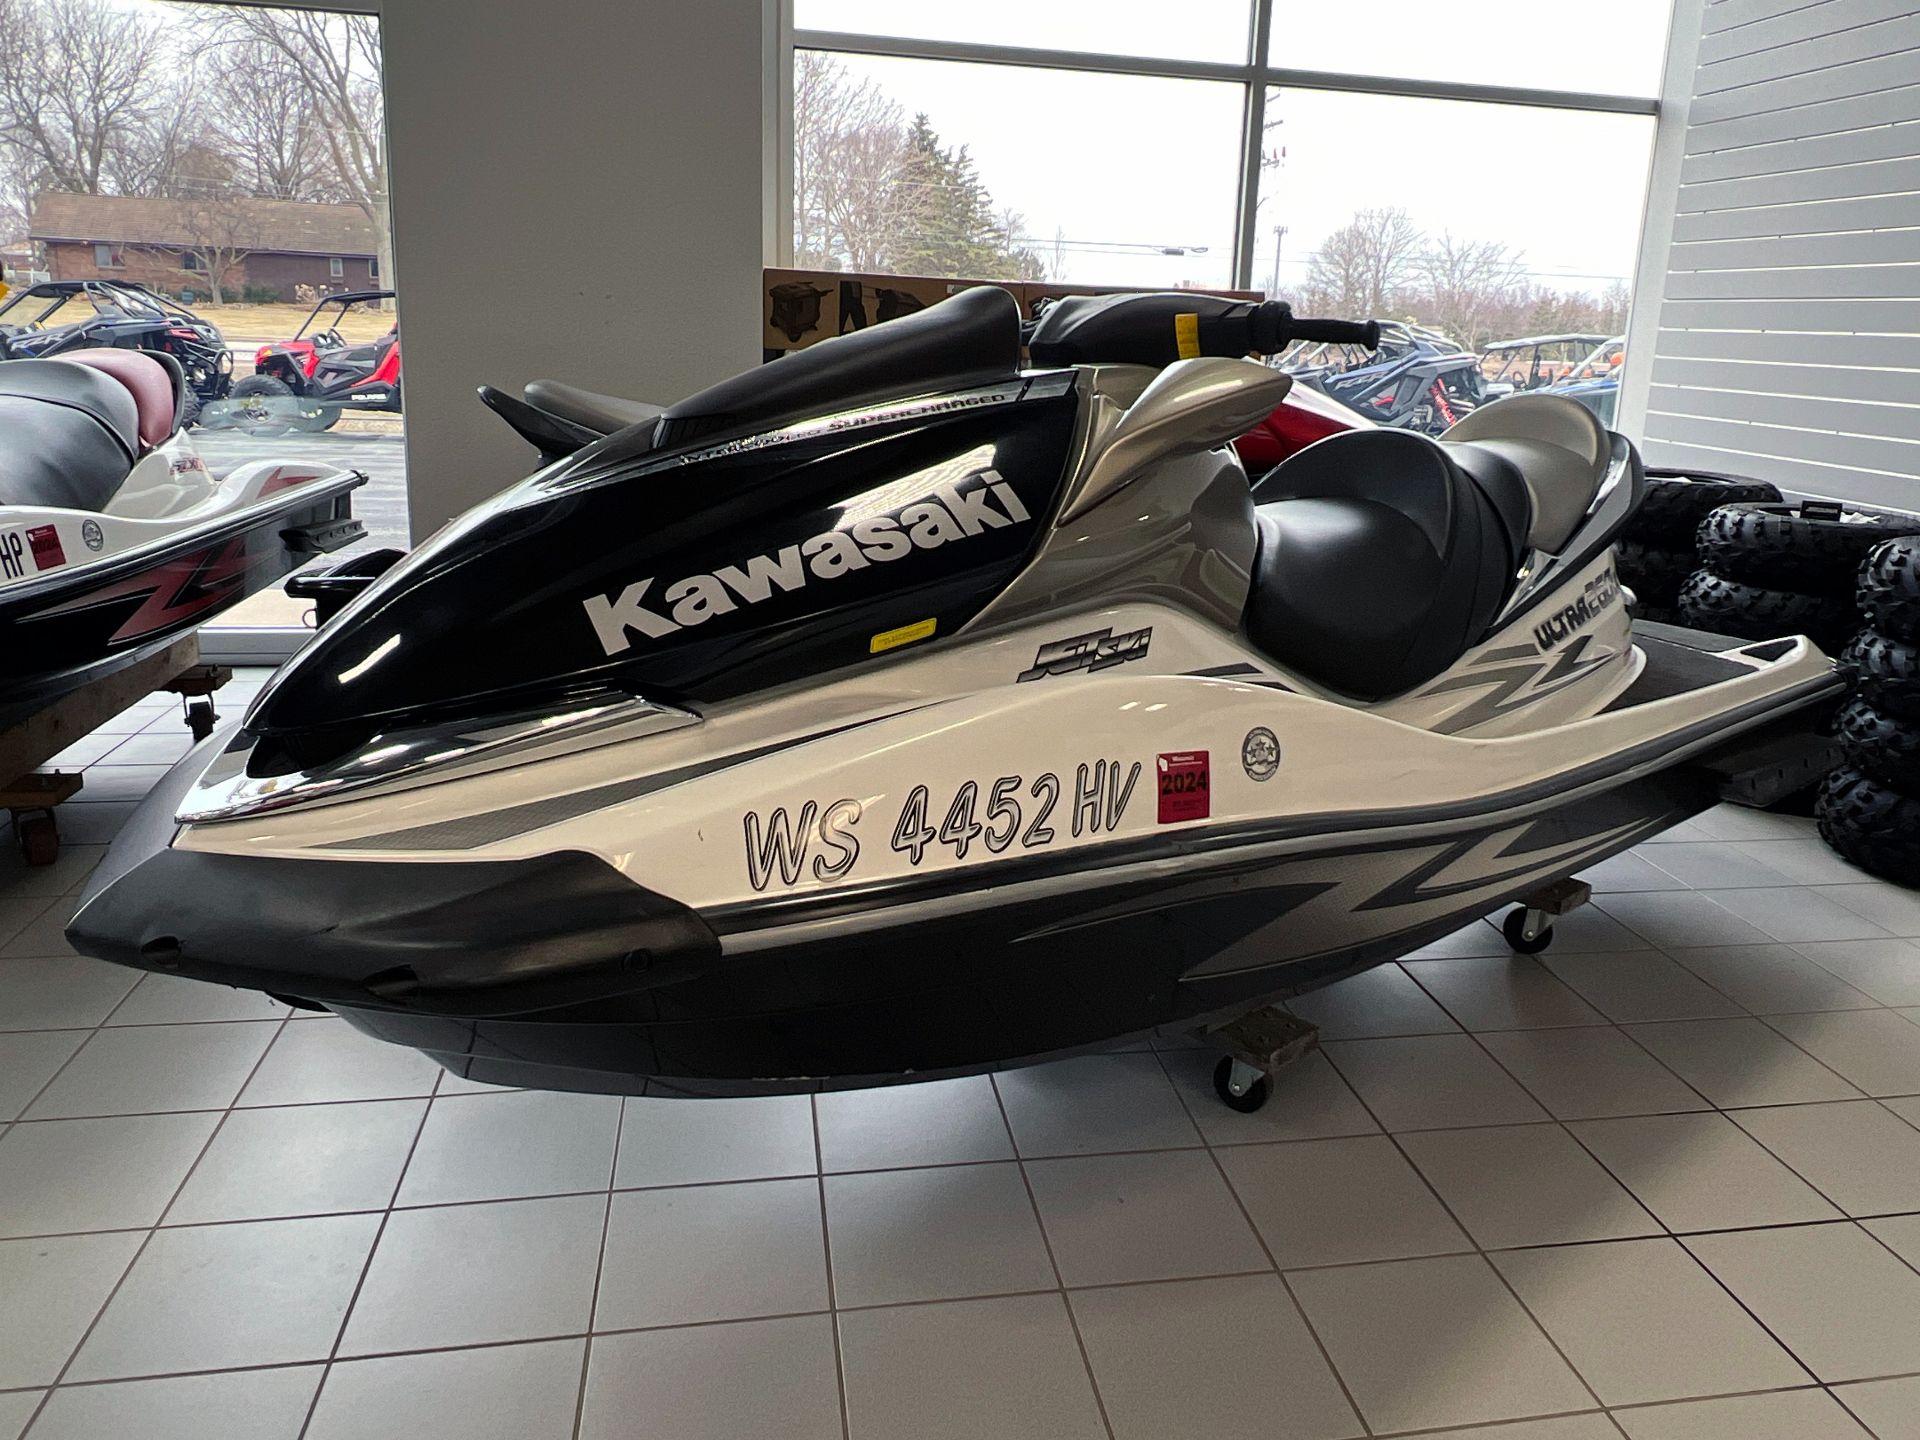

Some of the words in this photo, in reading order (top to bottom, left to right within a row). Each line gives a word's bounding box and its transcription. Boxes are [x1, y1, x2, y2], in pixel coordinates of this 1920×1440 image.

[828, 393, 1005, 431] SUPERCHARGED
[0, 531, 25, 579] HP
[582, 470, 1032, 656] Kawasaki
[1161, 770, 1208, 796] 2024
[743, 799, 864, 892] WS
[891, 772, 1061, 867] 4452
[1071, 758, 1142, 839] HV
